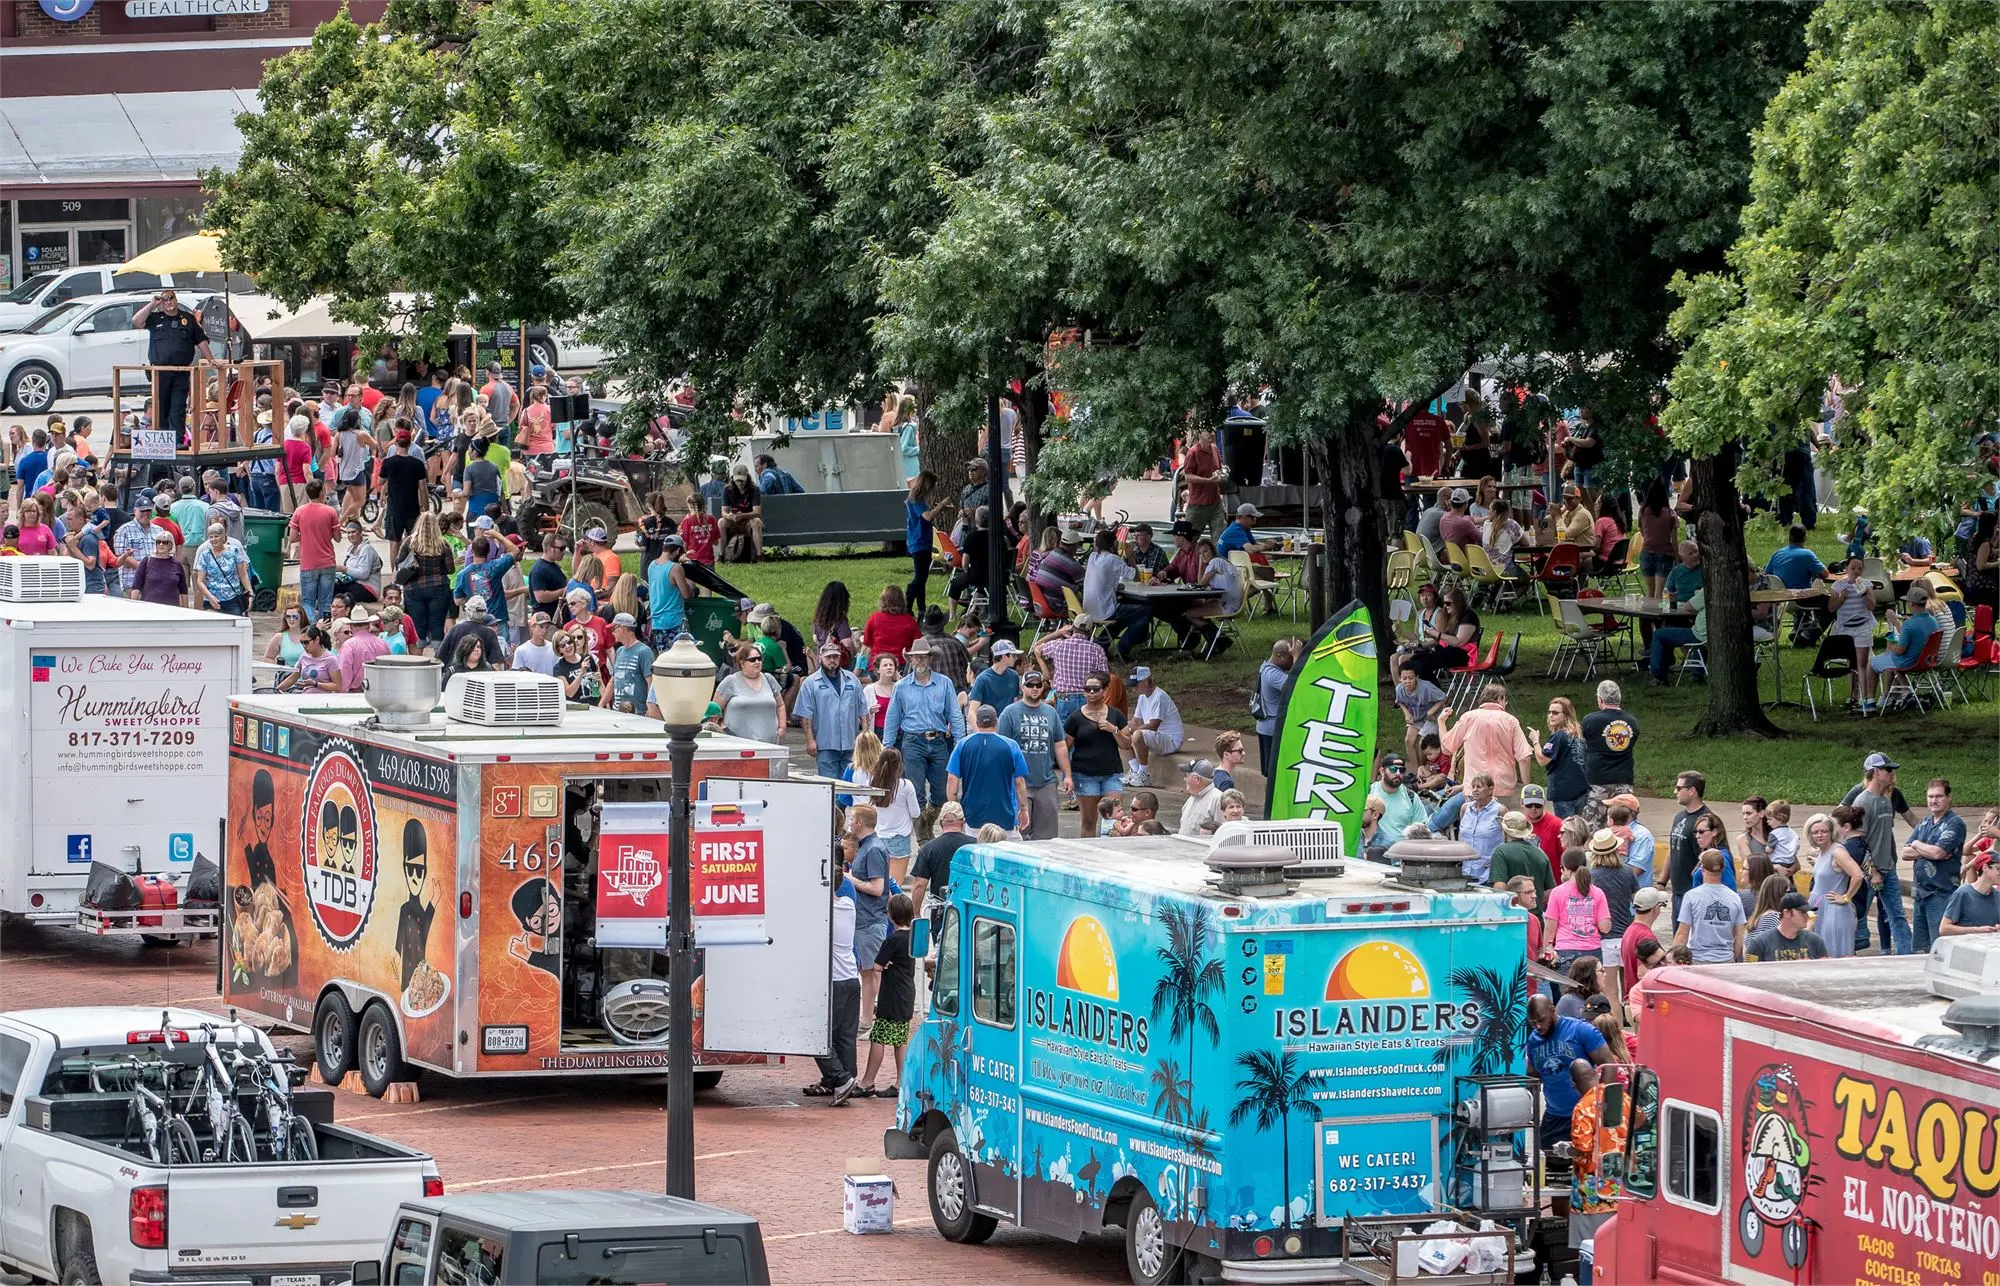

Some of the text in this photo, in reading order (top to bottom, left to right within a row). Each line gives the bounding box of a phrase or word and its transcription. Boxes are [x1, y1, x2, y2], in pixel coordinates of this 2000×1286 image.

[133, 0, 262, 15] HEALTHCARE
[62, 201, 81, 212] 509
[788, 409, 843, 431] ICE
[145, 432, 174, 443] STAR
[61, 655, 83, 673] We
[89, 654, 123, 674] Bake
[127, 654, 154, 674] You
[160, 653, 202, 674] Happy
[57, 684, 206, 725] Hummingbird
[105, 717, 201, 726] SWEET SHOPPE
[69, 731, 195, 746] 817-371-7209
[1287, 676, 1371, 821] TER
[57, 750, 203, 760] www.hummingbirdsweetshoppe.com
[58, 762, 203, 773] info@hummingbirdsweetshoppe.com
[378, 753, 450, 794] 469.608.1598
[311, 765, 334, 819] FAMOUS
[335, 761, 369, 823] DUMPLING
[499, 842, 562, 870] 469
[701, 841, 758, 861] FIRST
[605, 870, 656, 886] TRUCK
[701, 863, 757, 874] SATURDAY
[321, 870, 357, 909] TDB
[701, 884, 759, 904] JUNE
[1027, 988, 1149, 1055] ISLANDERS
[1275, 1002, 1480, 1038] ISLANDERS
[1309, 1038, 1445, 1052] Hawaiian Style Eats & Treats
[972, 1054, 1015, 1083] WE CATER
[1074, 1046, 1089, 1060] Style
[1090, 1050, 1102, 1064] Eats
[1109, 1055, 1127, 1071] Treats
[1309, 1063, 1445, 1078] www.IslandersFoodTruck.com
[1312, 1086, 1442, 1100] www.IslandersShaveIce.com
[1025, 1107, 1118, 1146] www.IslandersFoodTruck.com
[1129, 1137, 1222, 1176] www.IslandersShaveIce.com
[1339, 1152, 1416, 1168] WE CATER!
[1329, 1175, 1427, 1192] 682-317-3437
[1843, 1175, 2000, 1260] EL NORTEÑO
[1857, 1234, 1961, 1279] TACOS TORTAS
[1865, 1259, 1921, 1286] COCTELES
